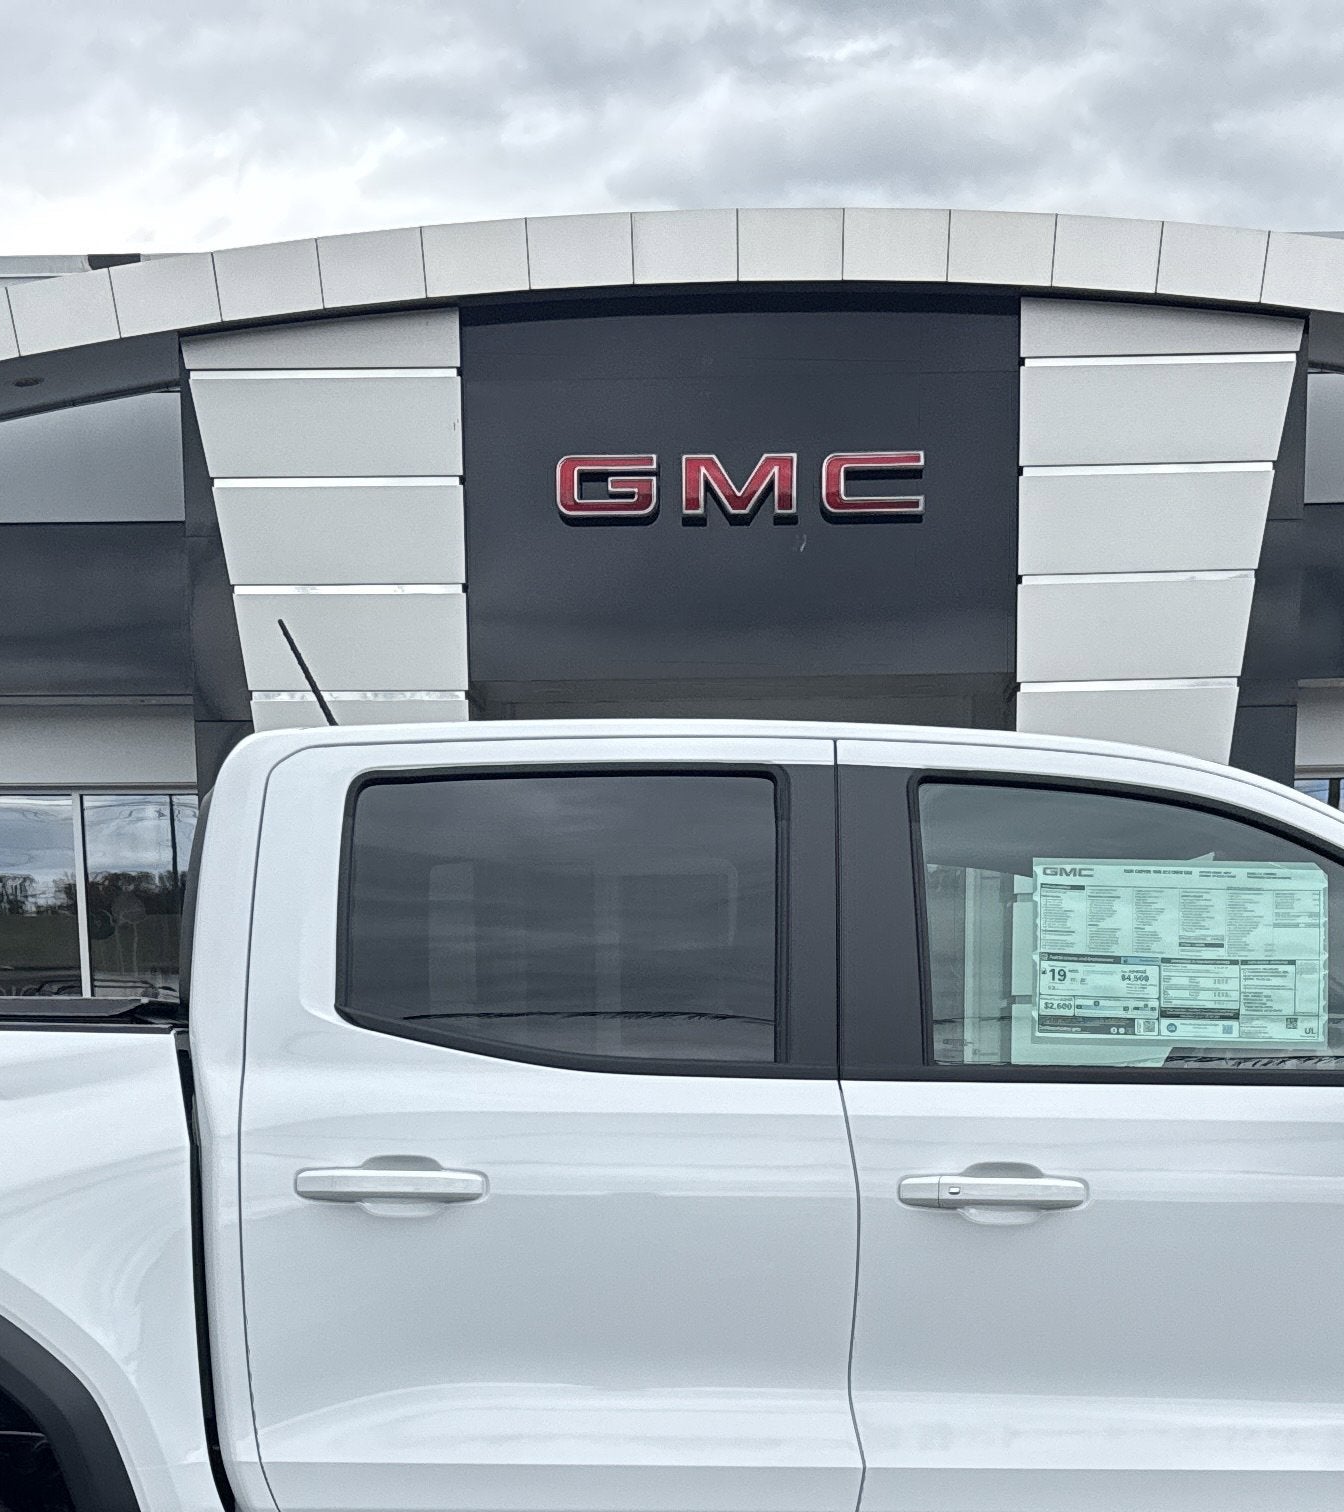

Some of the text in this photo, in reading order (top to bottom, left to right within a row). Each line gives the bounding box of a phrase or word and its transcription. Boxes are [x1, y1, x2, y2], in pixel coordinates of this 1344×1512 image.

[556, 451, 924, 518] GMC
[1042, 866, 1094, 877] GMC
[1048, 968, 1067, 982] 19
